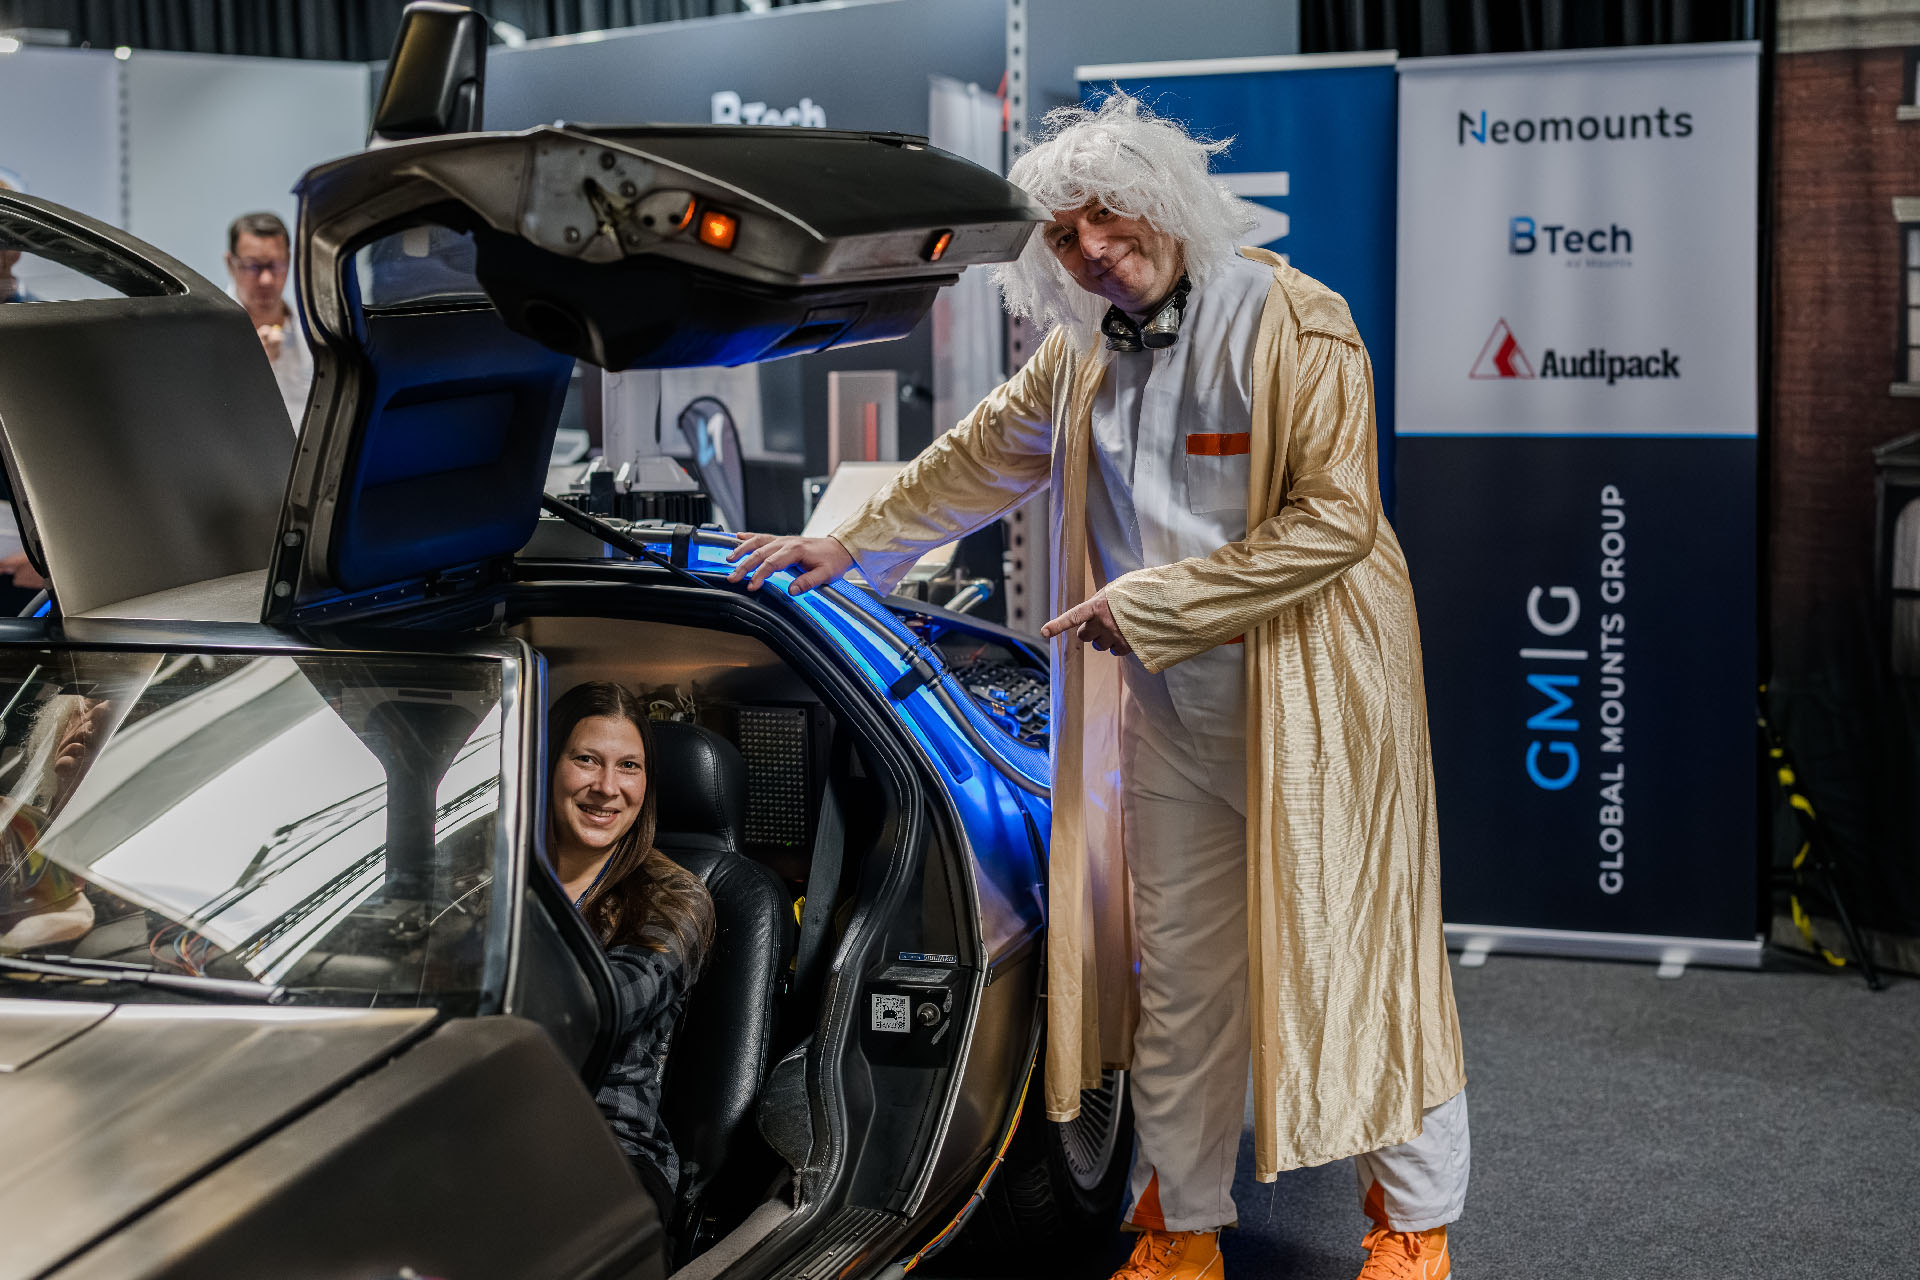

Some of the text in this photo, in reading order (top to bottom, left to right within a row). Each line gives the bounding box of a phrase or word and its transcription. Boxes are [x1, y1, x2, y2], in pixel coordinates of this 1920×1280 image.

[1458, 106, 1694, 146] Neomounts
[1540, 348, 1681, 386] Audipack
[1599, 484, 1626, 895] GLOBAL MOUNTS GROUP
